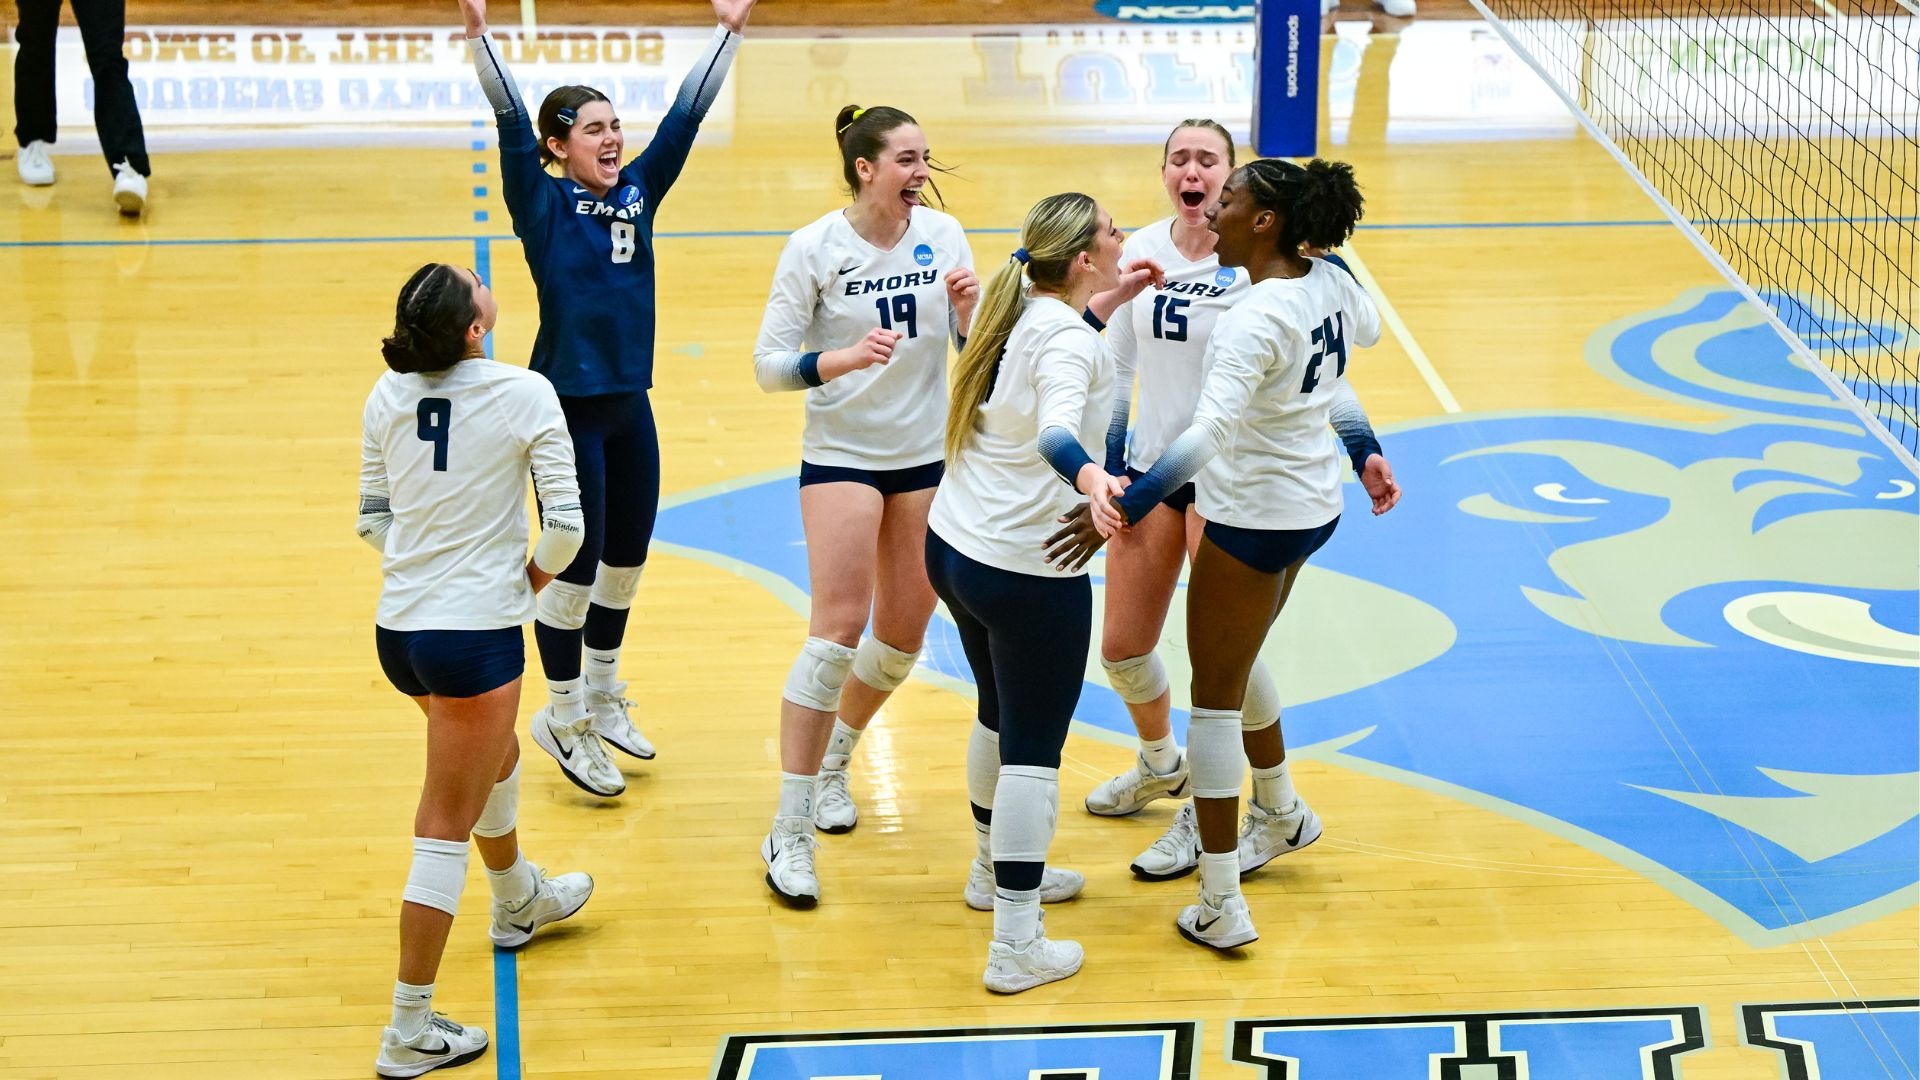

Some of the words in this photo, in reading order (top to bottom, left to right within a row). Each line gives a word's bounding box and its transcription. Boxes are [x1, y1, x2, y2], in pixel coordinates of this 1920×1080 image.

[1287, 15, 1298, 51] sports
[1286, 52, 1298, 97] imports
[610, 221, 635, 264] 8
[845, 269, 938, 296] EMORY
[1148, 279, 1227, 298] MORY
[875, 293, 918, 339] 19
[1152, 294, 1191, 342] 15
[1300, 310, 1347, 394] 24
[416, 397, 452, 472] 9
